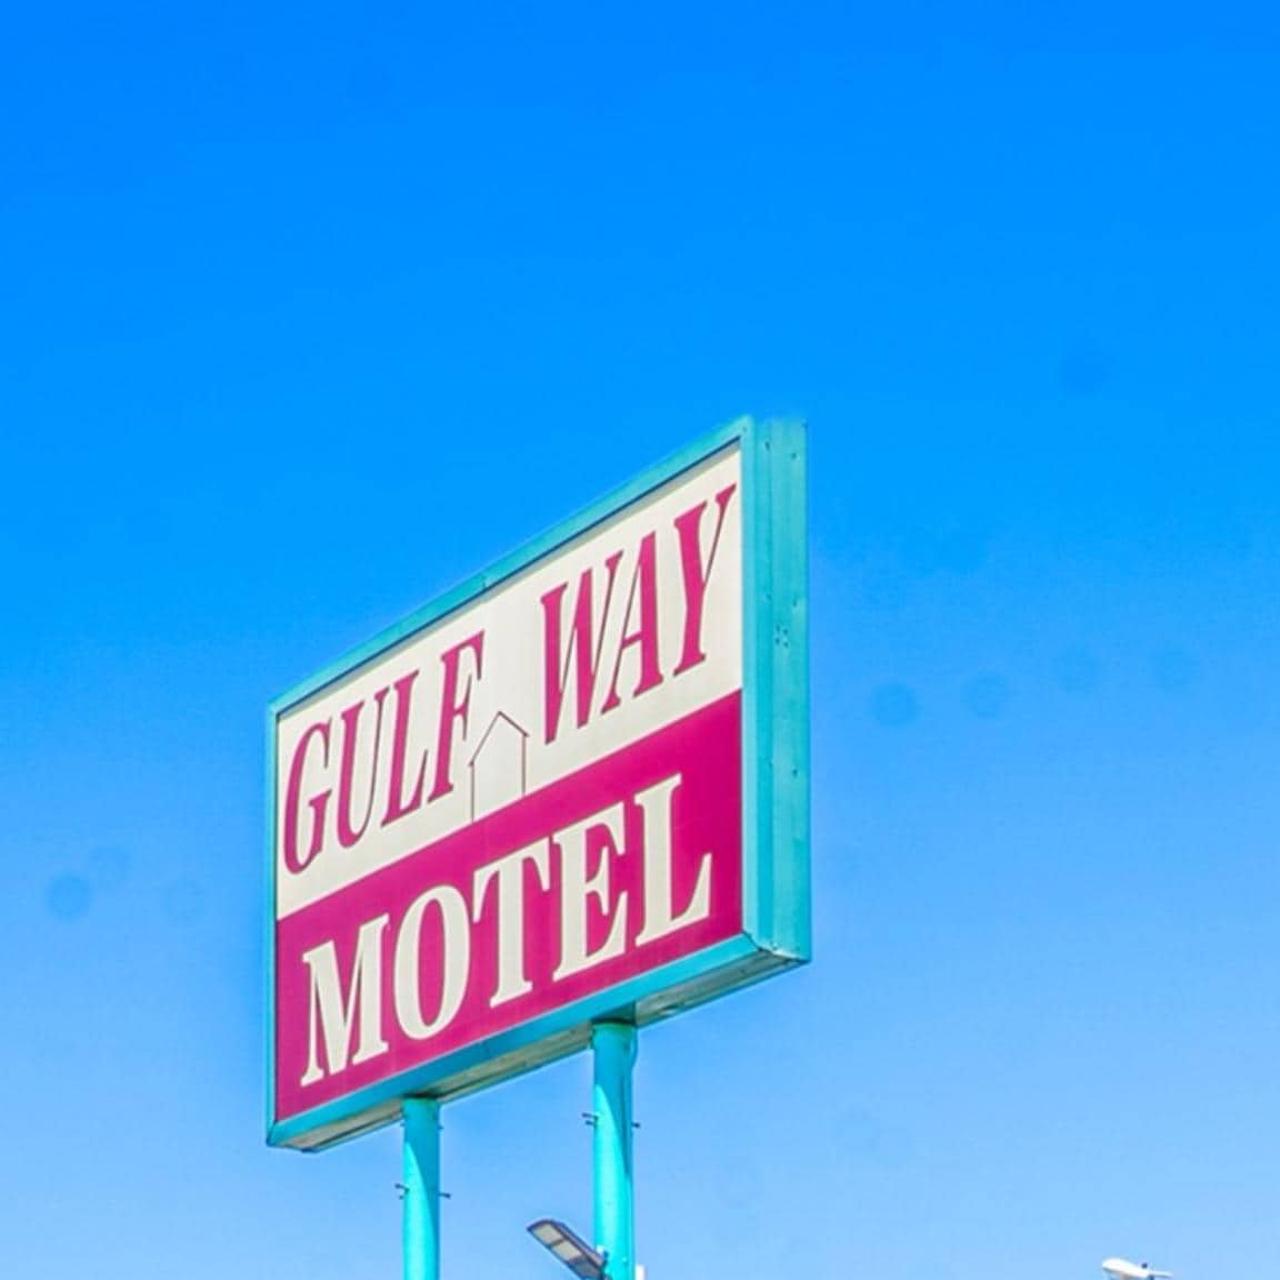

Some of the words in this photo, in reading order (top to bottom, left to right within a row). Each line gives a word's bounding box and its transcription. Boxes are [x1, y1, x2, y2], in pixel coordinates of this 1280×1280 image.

[284, 630, 485, 874] GULF
[541, 482, 737, 744] WAY
[301, 773, 713, 1086] MOTEL
